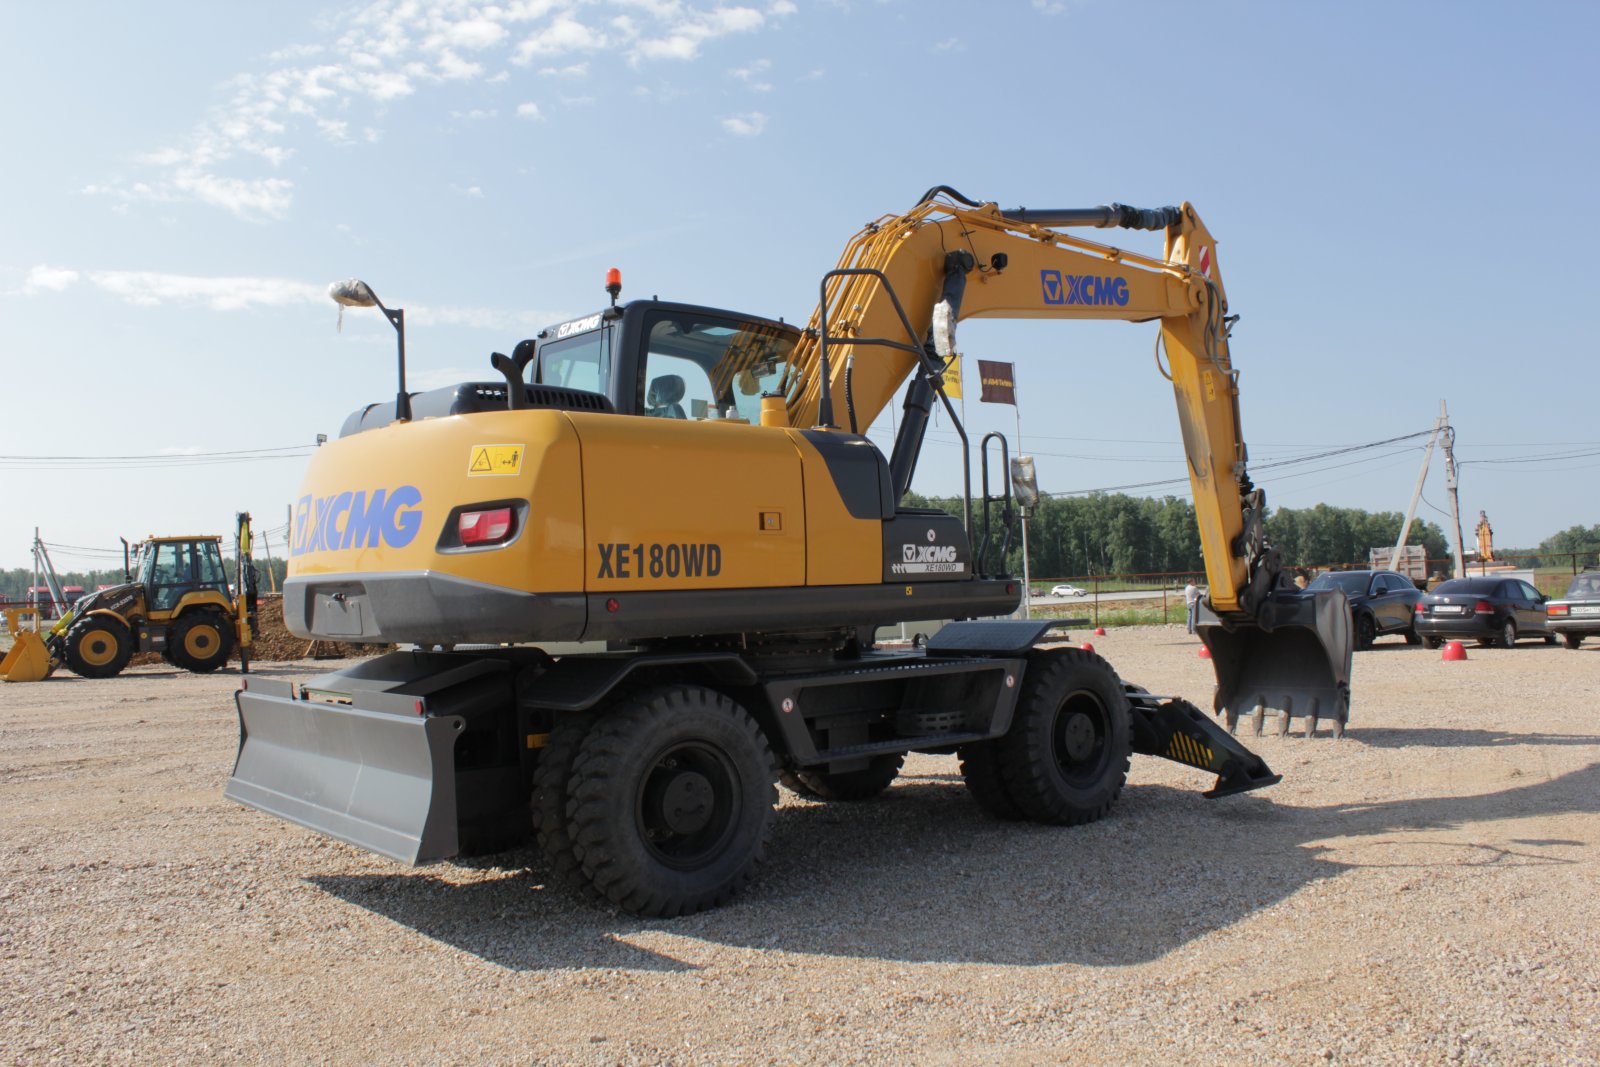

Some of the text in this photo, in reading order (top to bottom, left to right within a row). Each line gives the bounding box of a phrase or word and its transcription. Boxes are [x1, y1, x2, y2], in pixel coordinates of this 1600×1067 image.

[1065, 274, 1130, 307] XCMG
[567, 314, 601, 336] XCMG
[305, 485, 423, 553] XCMG
[597, 543, 722, 579] XE180WD
[916, 545, 957, 563] XCMG
